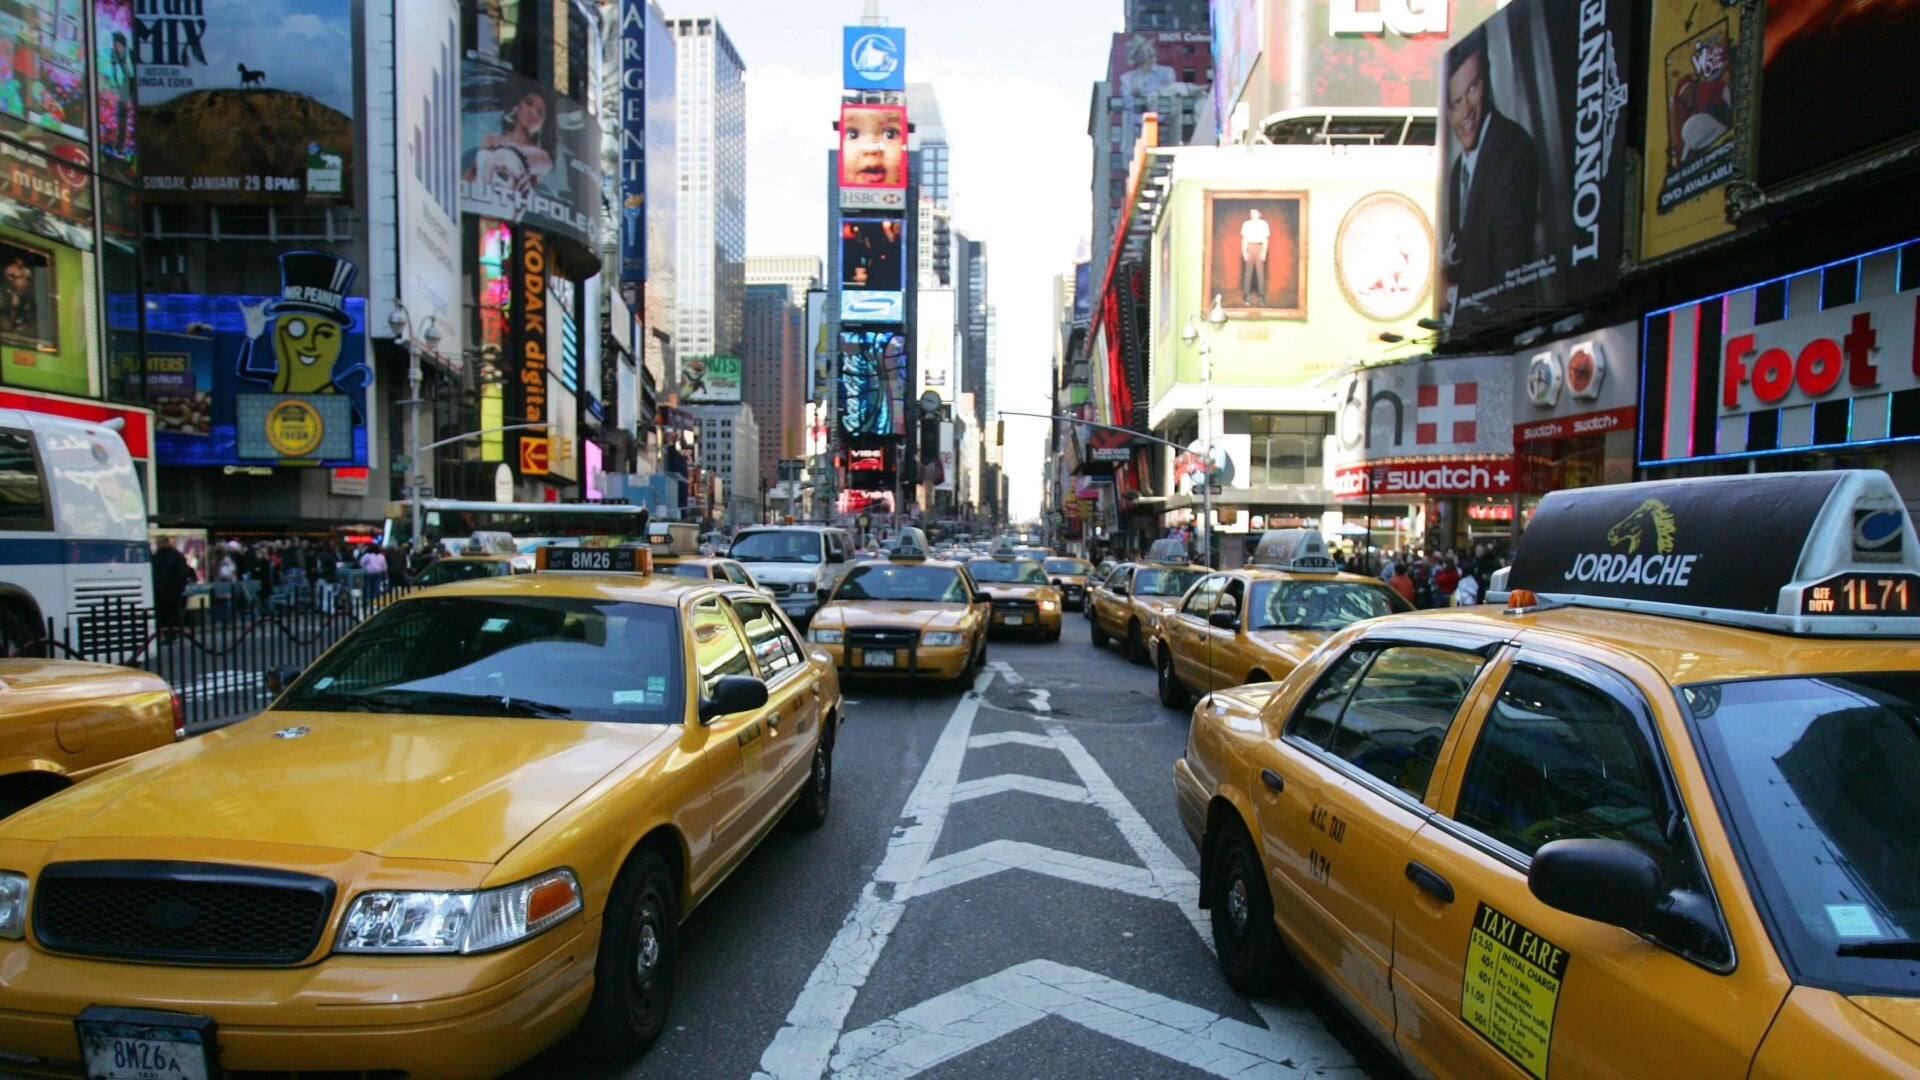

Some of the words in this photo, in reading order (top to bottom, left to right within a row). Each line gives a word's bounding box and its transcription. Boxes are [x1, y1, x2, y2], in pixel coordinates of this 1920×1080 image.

[12, 169, 71, 203] music
[191, 176, 240, 189] JANUARY
[244, 175, 260, 190] 29
[1661, 186, 1683, 206] DVD
[843, 192, 880, 205] HSBC
[524, 229, 544, 334] KODAK
[304, 286, 343, 309] PEANUT
[1723, 312, 1878, 408] Foot
[521, 340, 546, 431] digital
[1092, 447, 1130, 455] LOEWS
[572, 551, 610, 568] 8M26
[1563, 553, 1698, 587] JORDACHE
[1809, 599, 1835, 612] DUTY
[1813, 587, 1831, 600] OFF
[1843, 578, 1908, 611] 1L71
[1482, 906, 1517, 946] TAXI
[1519, 929, 1562, 974] FARE
[1502, 951, 1526, 974] INITIAL
[1528, 968, 1556, 993] CHARGE
